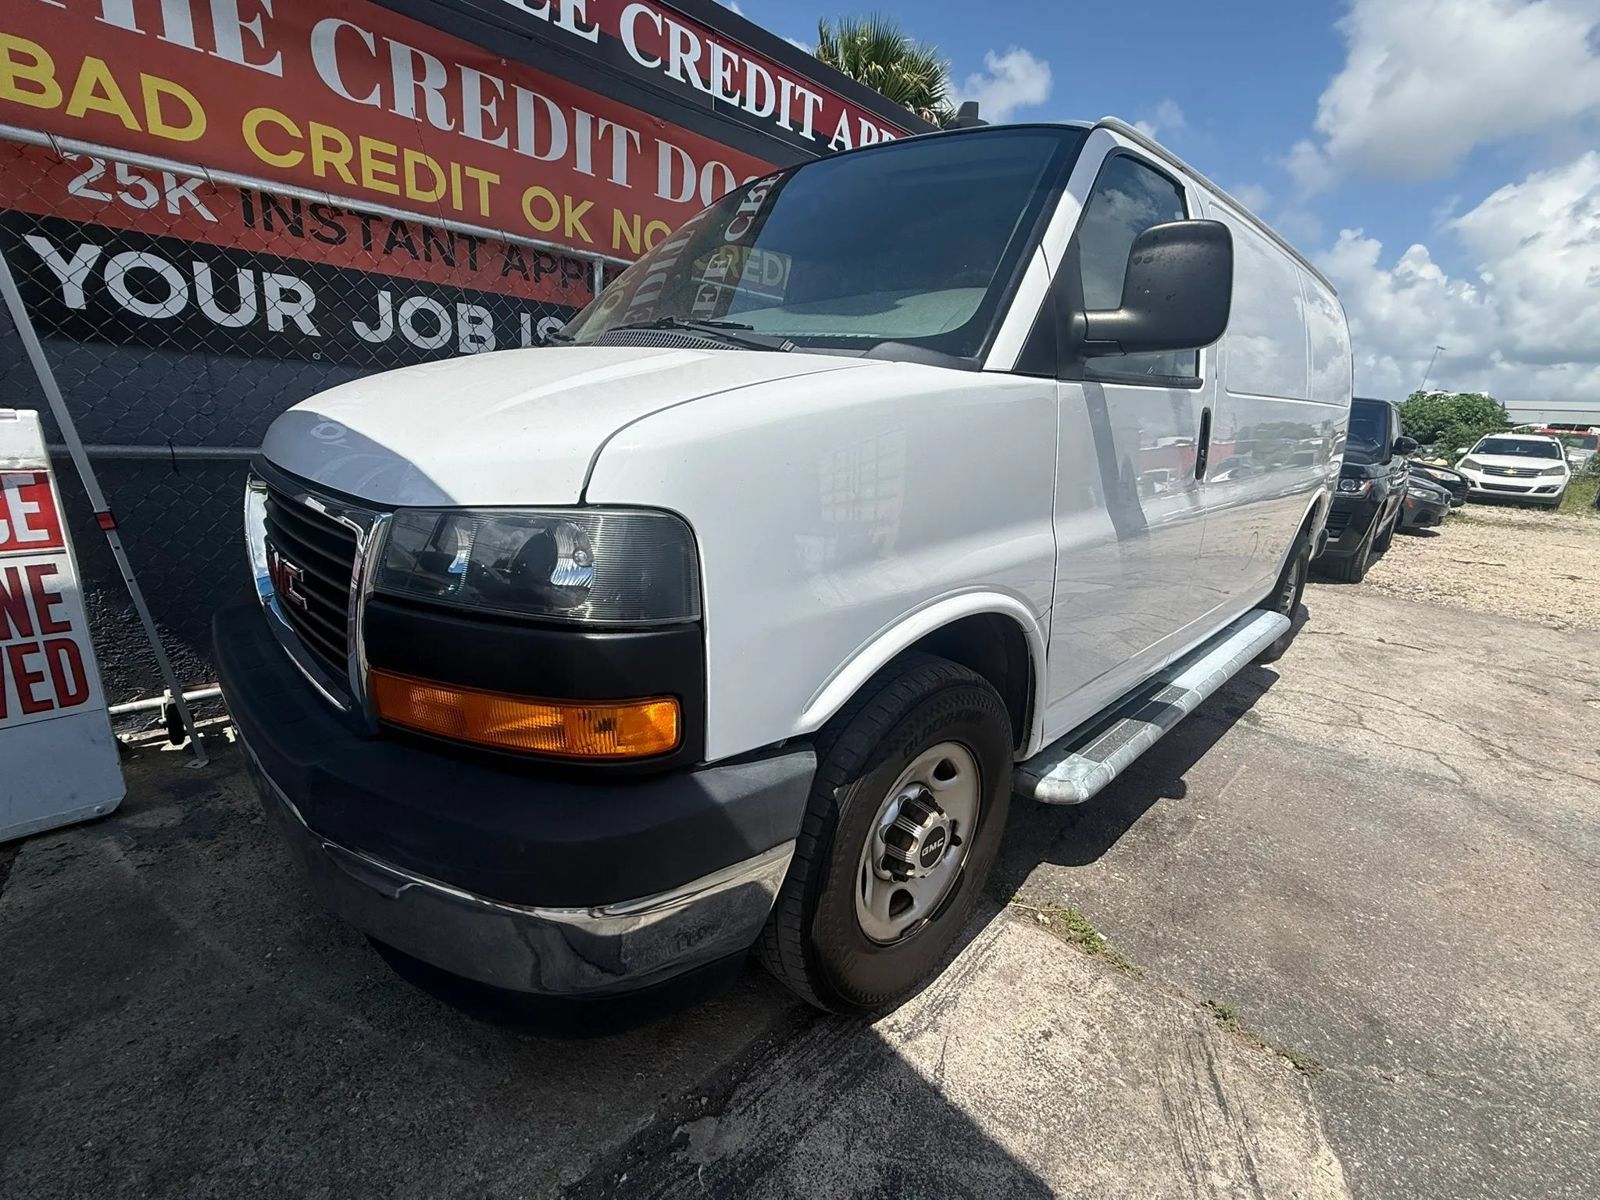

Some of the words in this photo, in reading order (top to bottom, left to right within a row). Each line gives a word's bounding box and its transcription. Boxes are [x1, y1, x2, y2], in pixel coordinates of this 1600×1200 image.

[310, 17, 641, 189] CREDIT
[654, 138, 759, 208] DO
[619, 3, 824, 141] CREDIT
[0, 32, 207, 142] BAD
[242, 108, 500, 217] CREDIT
[521, 186, 596, 244] OK
[63, 151, 219, 223] 25K
[239, 187, 487, 272] INSTANT
[22, 233, 322, 337] YOUR
[352, 290, 498, 354] JOB
[0, 474, 50, 545] E
[0, 637, 90, 719] ED
[921, 837, 945, 857] GMC
